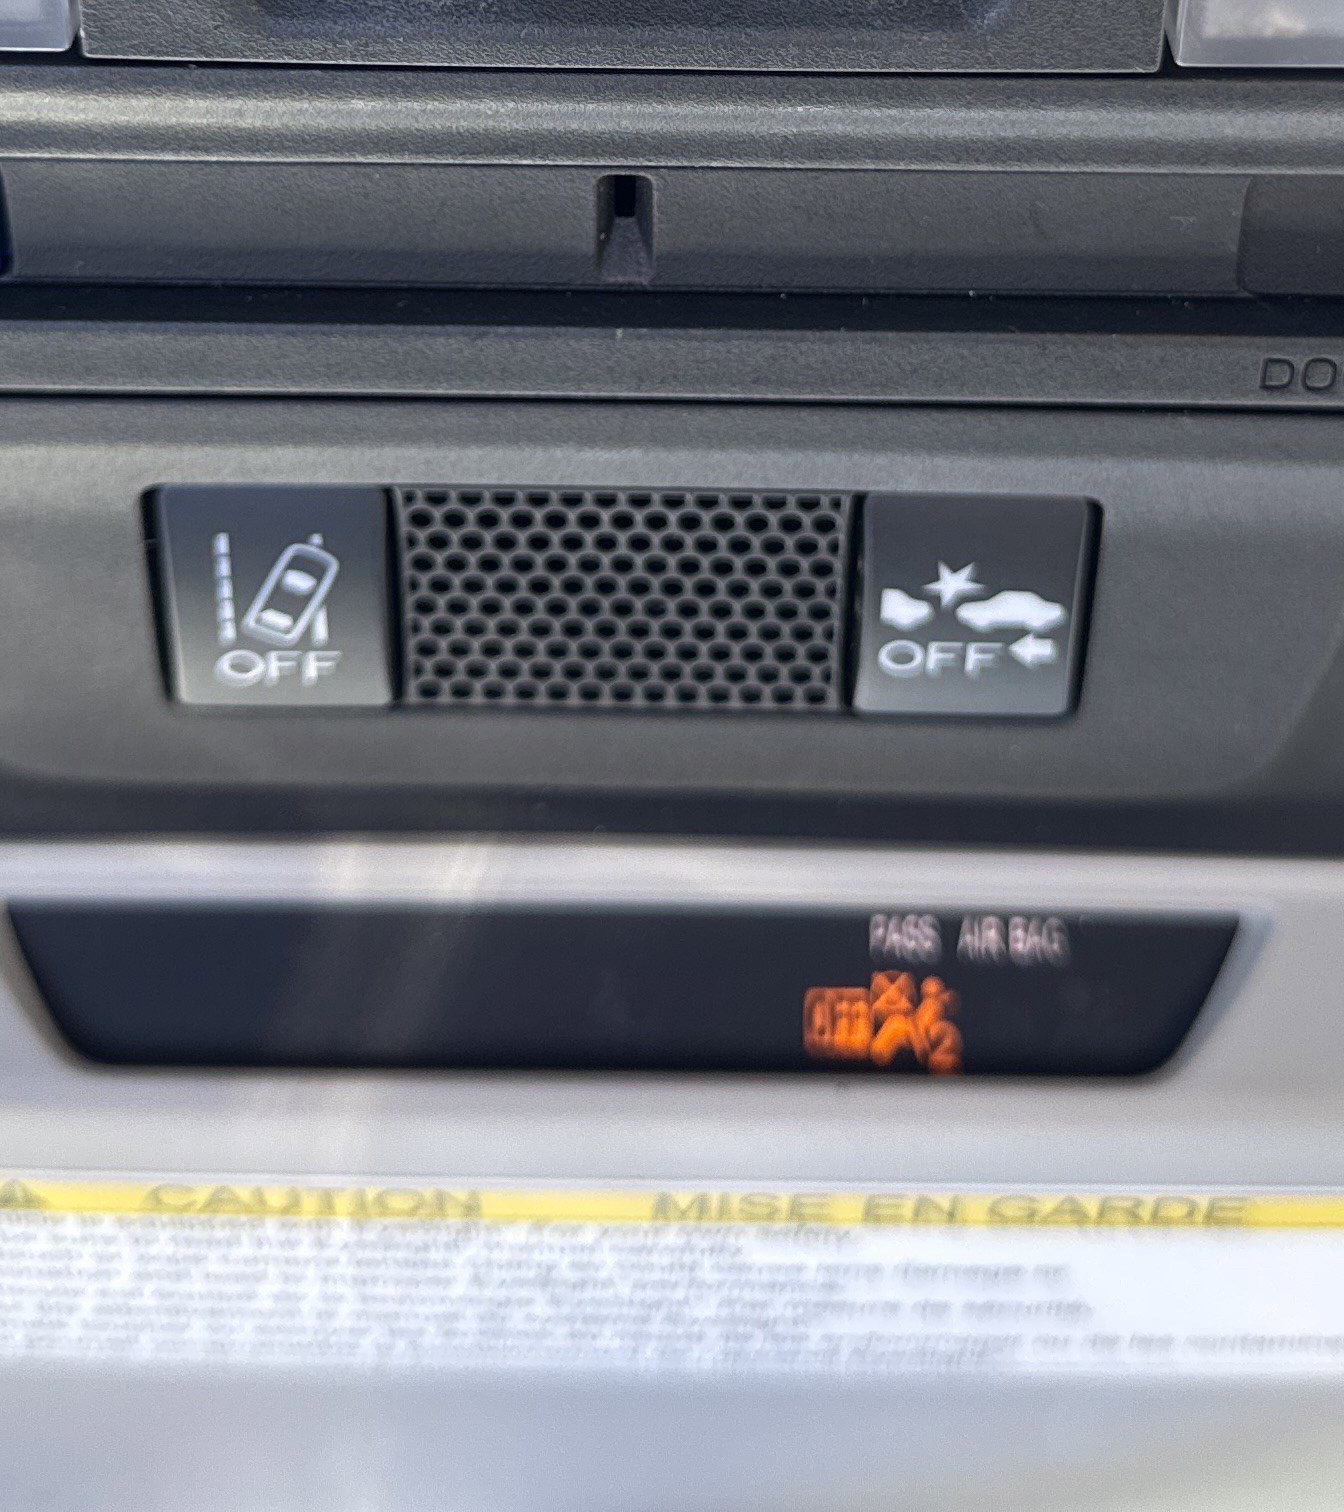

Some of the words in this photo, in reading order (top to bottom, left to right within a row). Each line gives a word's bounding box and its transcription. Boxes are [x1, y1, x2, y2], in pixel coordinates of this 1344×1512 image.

[212, 649, 342, 685] OFF
[878, 641, 1004, 678] OFF
[869, 913, 941, 959] PASS
[958, 915, 1005, 959] AIR
[1009, 916, 1069, 963] BAG
[142, 1184, 482, 1220] CAUTION
[654, 1191, 834, 1224] MISE
[862, 1194, 960, 1226] EN
[986, 1194, 1250, 1228] GARDE
